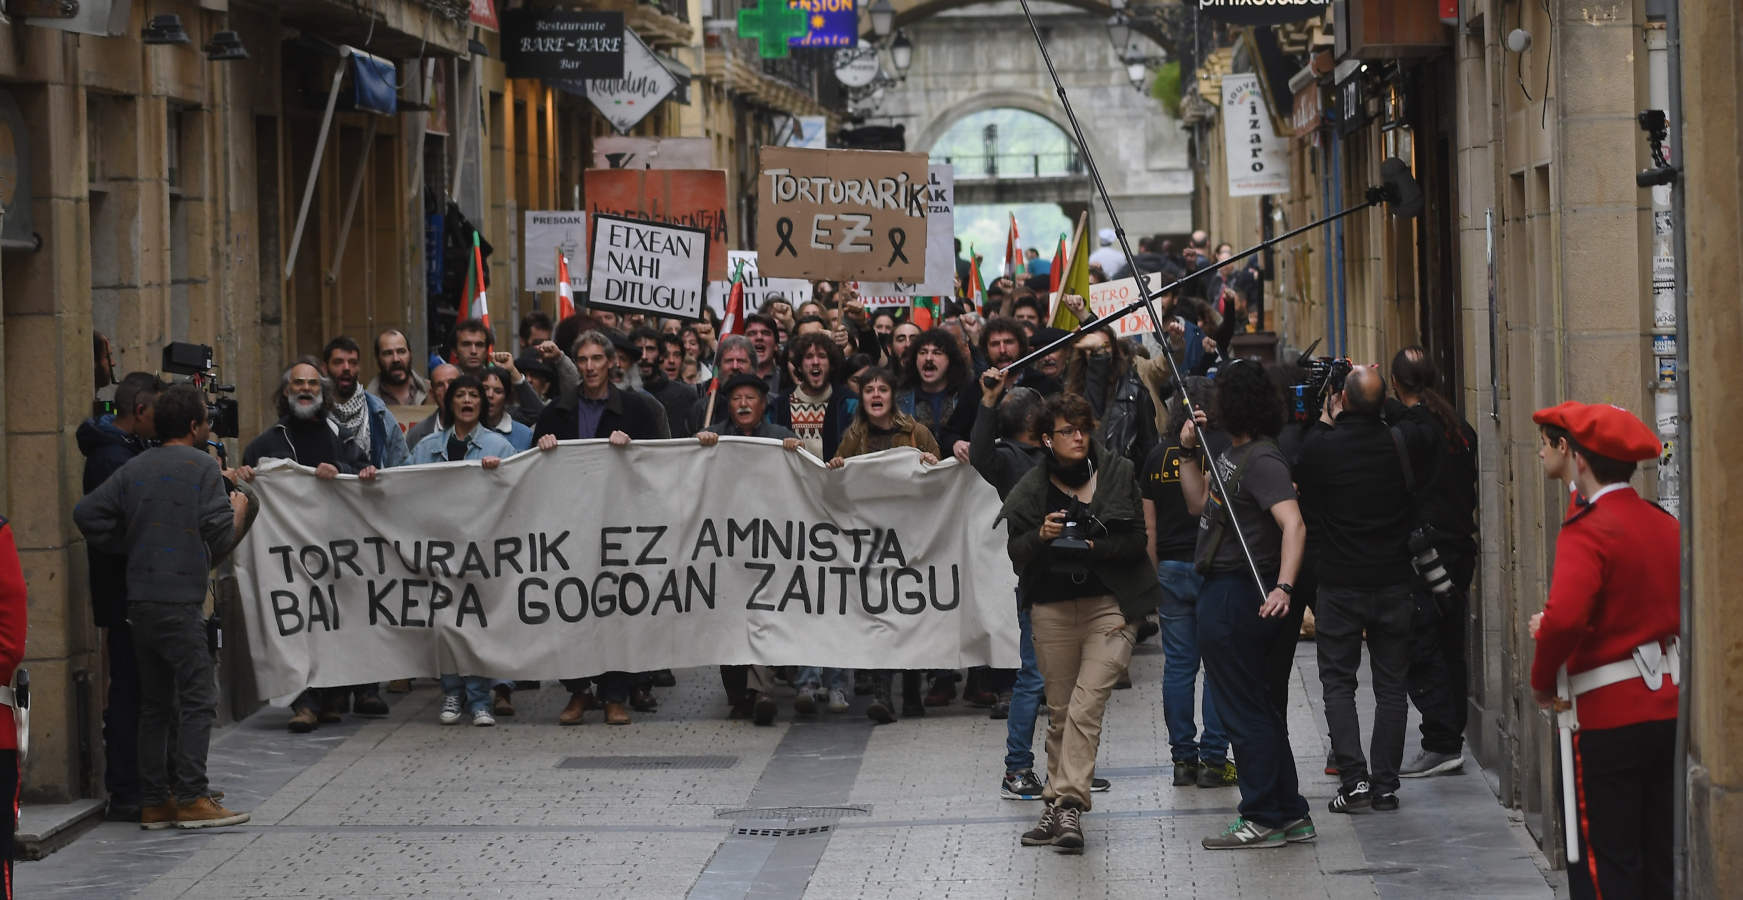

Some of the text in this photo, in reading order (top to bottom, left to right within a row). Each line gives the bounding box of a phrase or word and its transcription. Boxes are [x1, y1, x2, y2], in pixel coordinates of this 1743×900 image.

[536, 21, 606, 31] Restaurante
[560, 59, 581, 69] Bar
[1249, 101, 1264, 172] izaro
[533, 216, 581, 225] PRESOAK
[811, 213, 872, 253] EZ
[610, 224, 691, 258] ETXEAN
[607, 251, 660, 279] NAHI
[269, 531, 570, 584] TORTURARIK
[601, 526, 667, 567] EZ
[270, 561, 960, 636] BAI KEPA GOGOAN ZAITUGU
